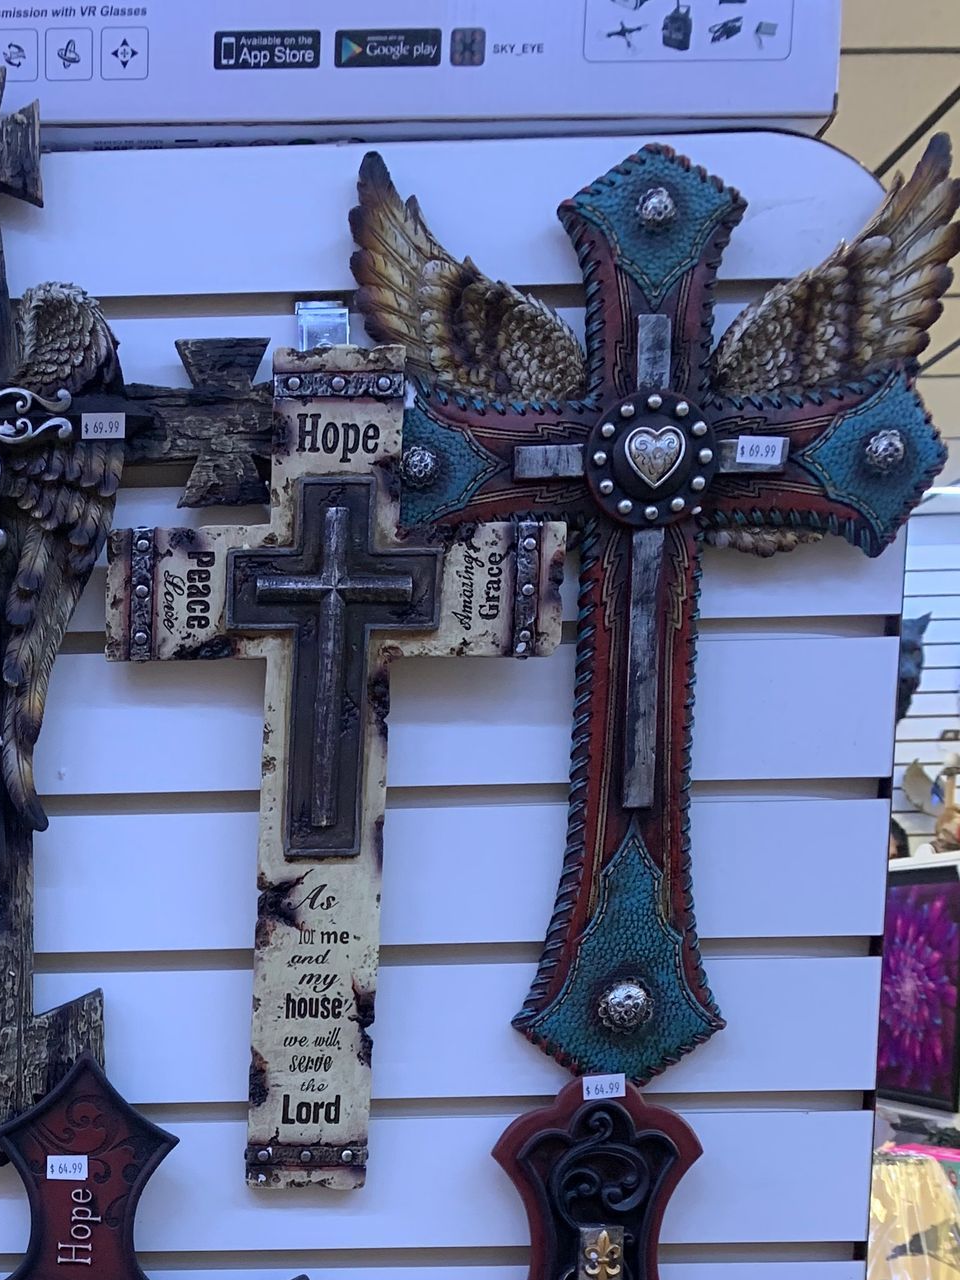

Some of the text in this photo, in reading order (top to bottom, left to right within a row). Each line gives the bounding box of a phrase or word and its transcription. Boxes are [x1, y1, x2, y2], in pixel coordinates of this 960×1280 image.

[51, 6, 77, 18] with
[80, 6, 97, 17] VR
[100, 6, 148, 17] Glasses
[240, 36, 313, 46] Available on the
[492, 43, 545, 56] SKY_EYE
[239, 47, 315, 66] App Store
[366, 42, 438, 60] Google play
[93, 420, 120, 434] 69.99
[295, 413, 381, 464] Hope
[749, 444, 777, 458] 69.99
[186, 550, 216, 631] Peace
[452, 537, 484, 632] Amazing
[477, 551, 504, 621] Grace
[162, 568, 185, 635] Love
[292, 883, 340, 912] As
[298, 928, 350, 945] for me
[287, 949, 329, 966] and
[297, 971, 341, 994] my
[284, 995, 344, 1020] house
[283, 1026, 341, 1048] we will
[288, 1054, 334, 1073] serve
[300, 1079, 329, 1092] the
[281, 1094, 342, 1125] Lord
[58, 1162, 83, 1175] 64.99
[57, 1188, 101, 1266] Hope
